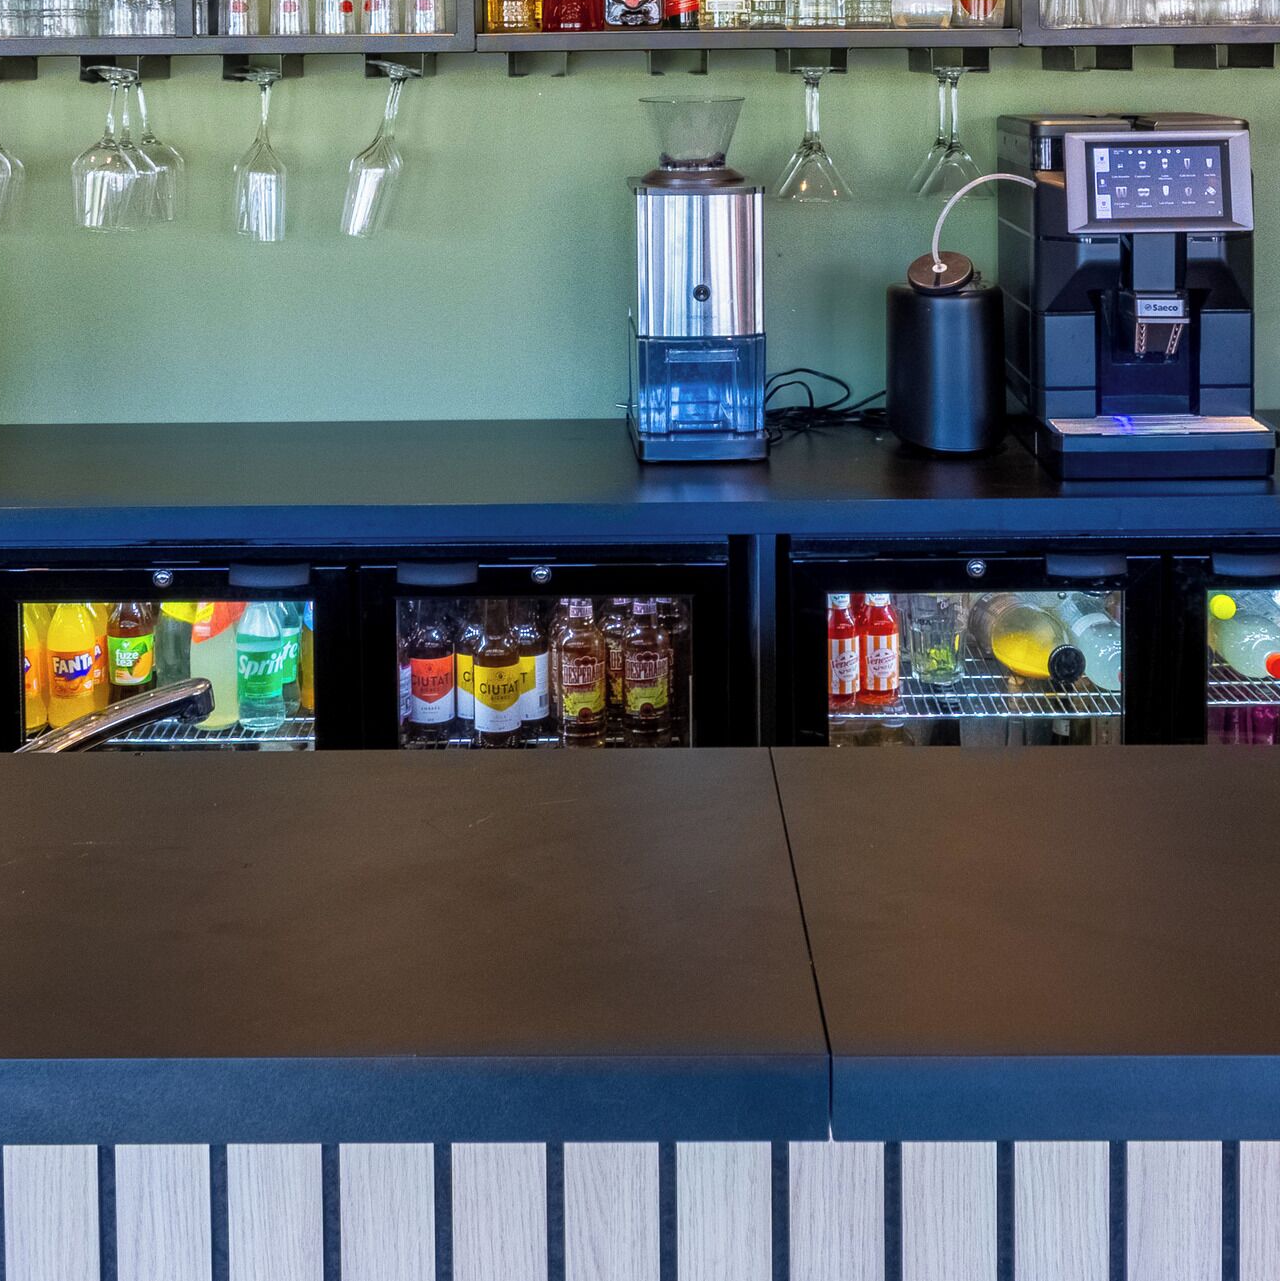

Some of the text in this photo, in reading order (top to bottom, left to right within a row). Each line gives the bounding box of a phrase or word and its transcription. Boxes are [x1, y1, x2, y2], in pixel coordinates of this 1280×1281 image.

[1152, 303, 1179, 312] Saeco
[116, 649, 139, 660] fuze
[480, 680, 518, 695] CIUTAT
